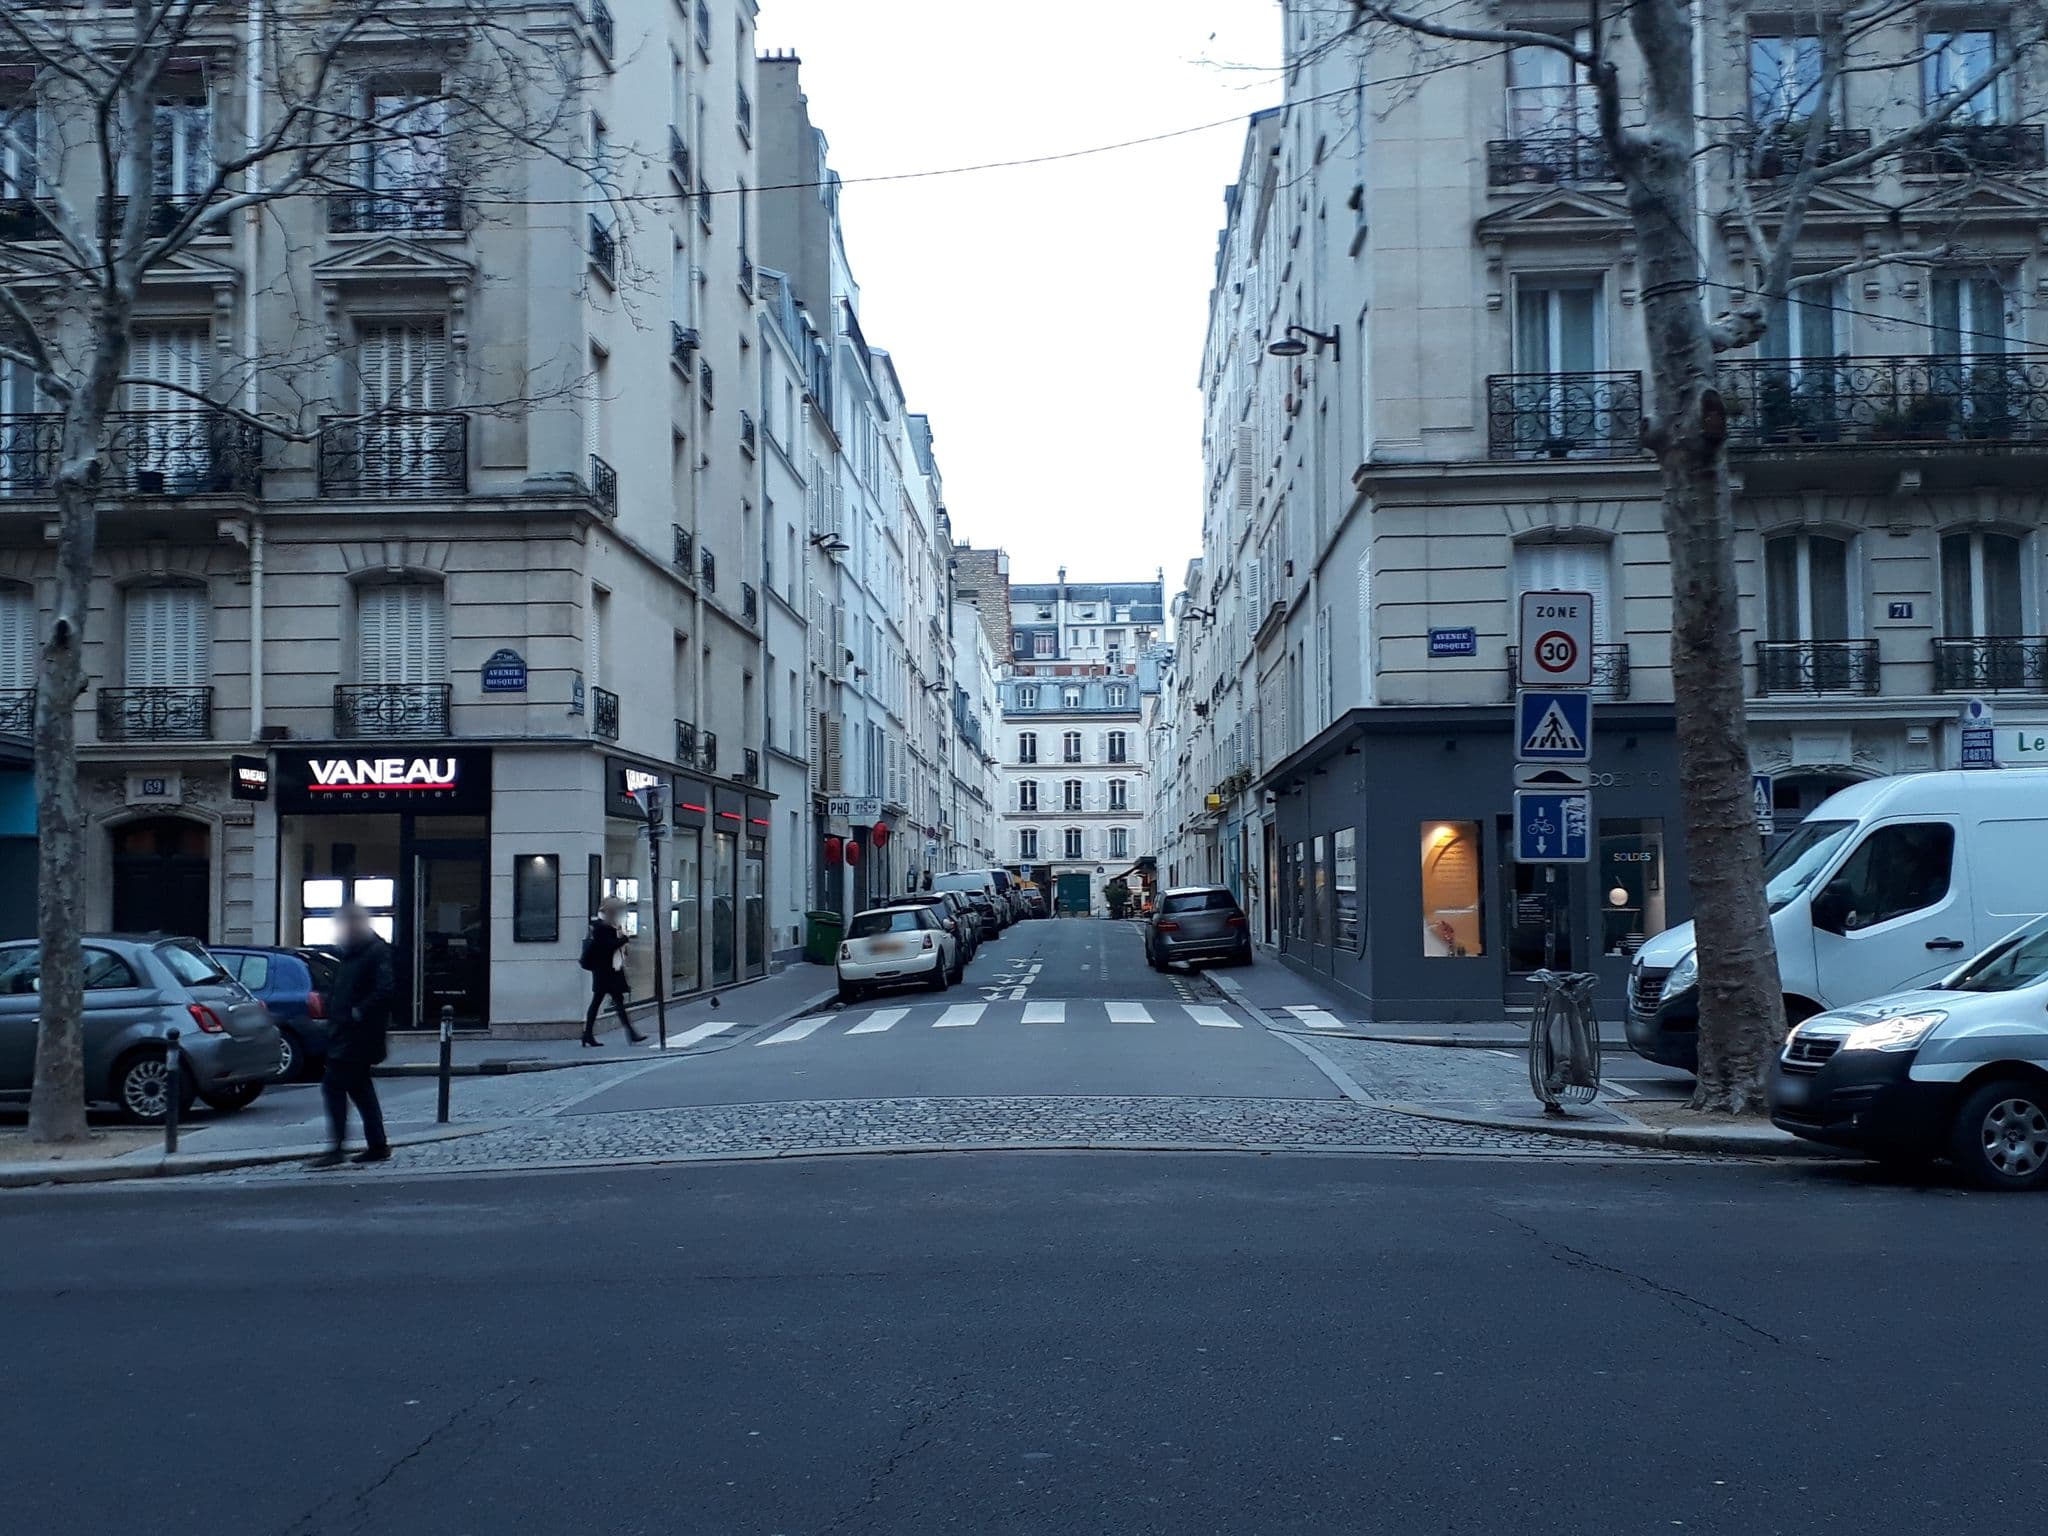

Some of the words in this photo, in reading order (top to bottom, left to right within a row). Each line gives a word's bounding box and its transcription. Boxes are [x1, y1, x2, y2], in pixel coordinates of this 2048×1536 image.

[1536, 606, 1577, 618] ZONE
[1543, 643, 1569, 661] 30
[488, 669, 521, 677] AVENUE
[486, 679, 523, 687] BOSQUET
[2018, 731, 2046, 752] Le
[239, 768, 267, 783] VANEAU
[308, 758, 456, 785] VANEAU
[310, 790, 457, 799] immobilier
[1613, 852, 1651, 862] SOLDES
